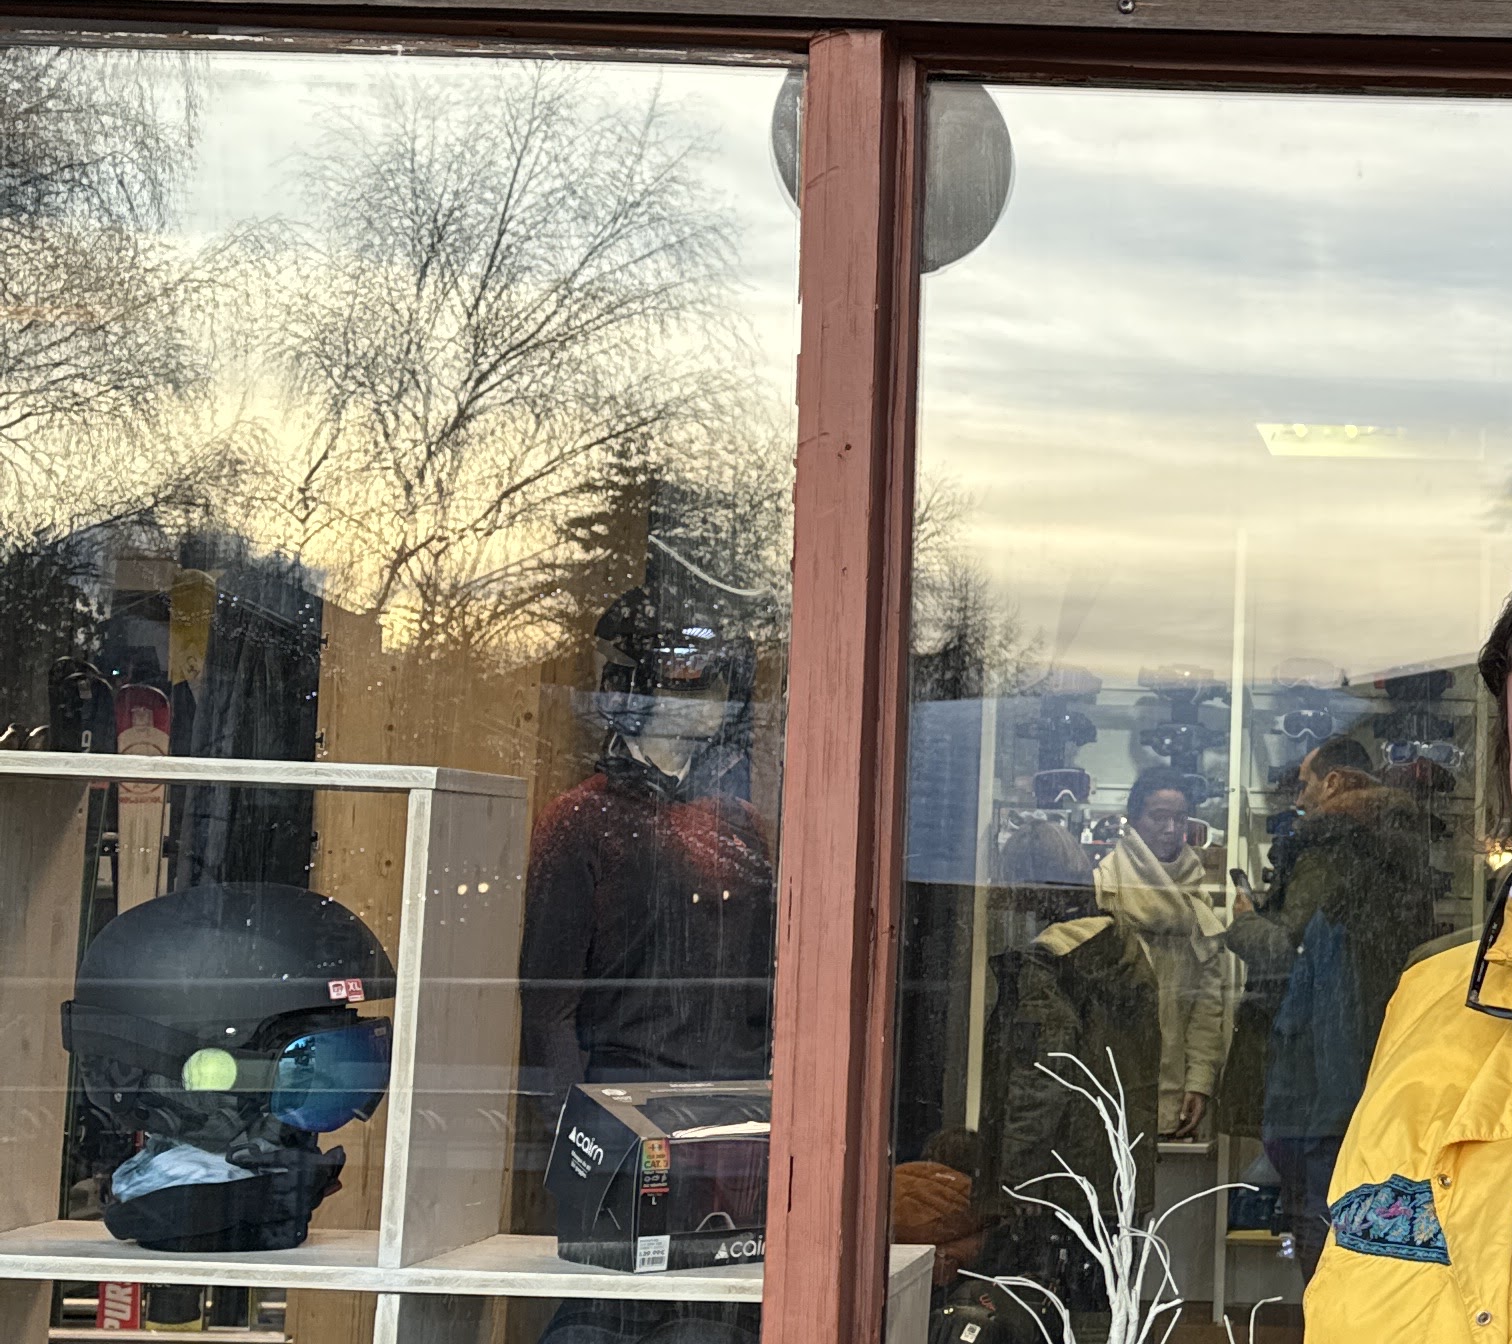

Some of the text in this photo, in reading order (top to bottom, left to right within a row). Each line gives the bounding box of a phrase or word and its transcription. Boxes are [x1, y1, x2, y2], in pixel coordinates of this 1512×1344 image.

[347, 981, 362, 992] XL
[574, 1131, 604, 1166] cairn
[103, 1281, 135, 1329] PUR
